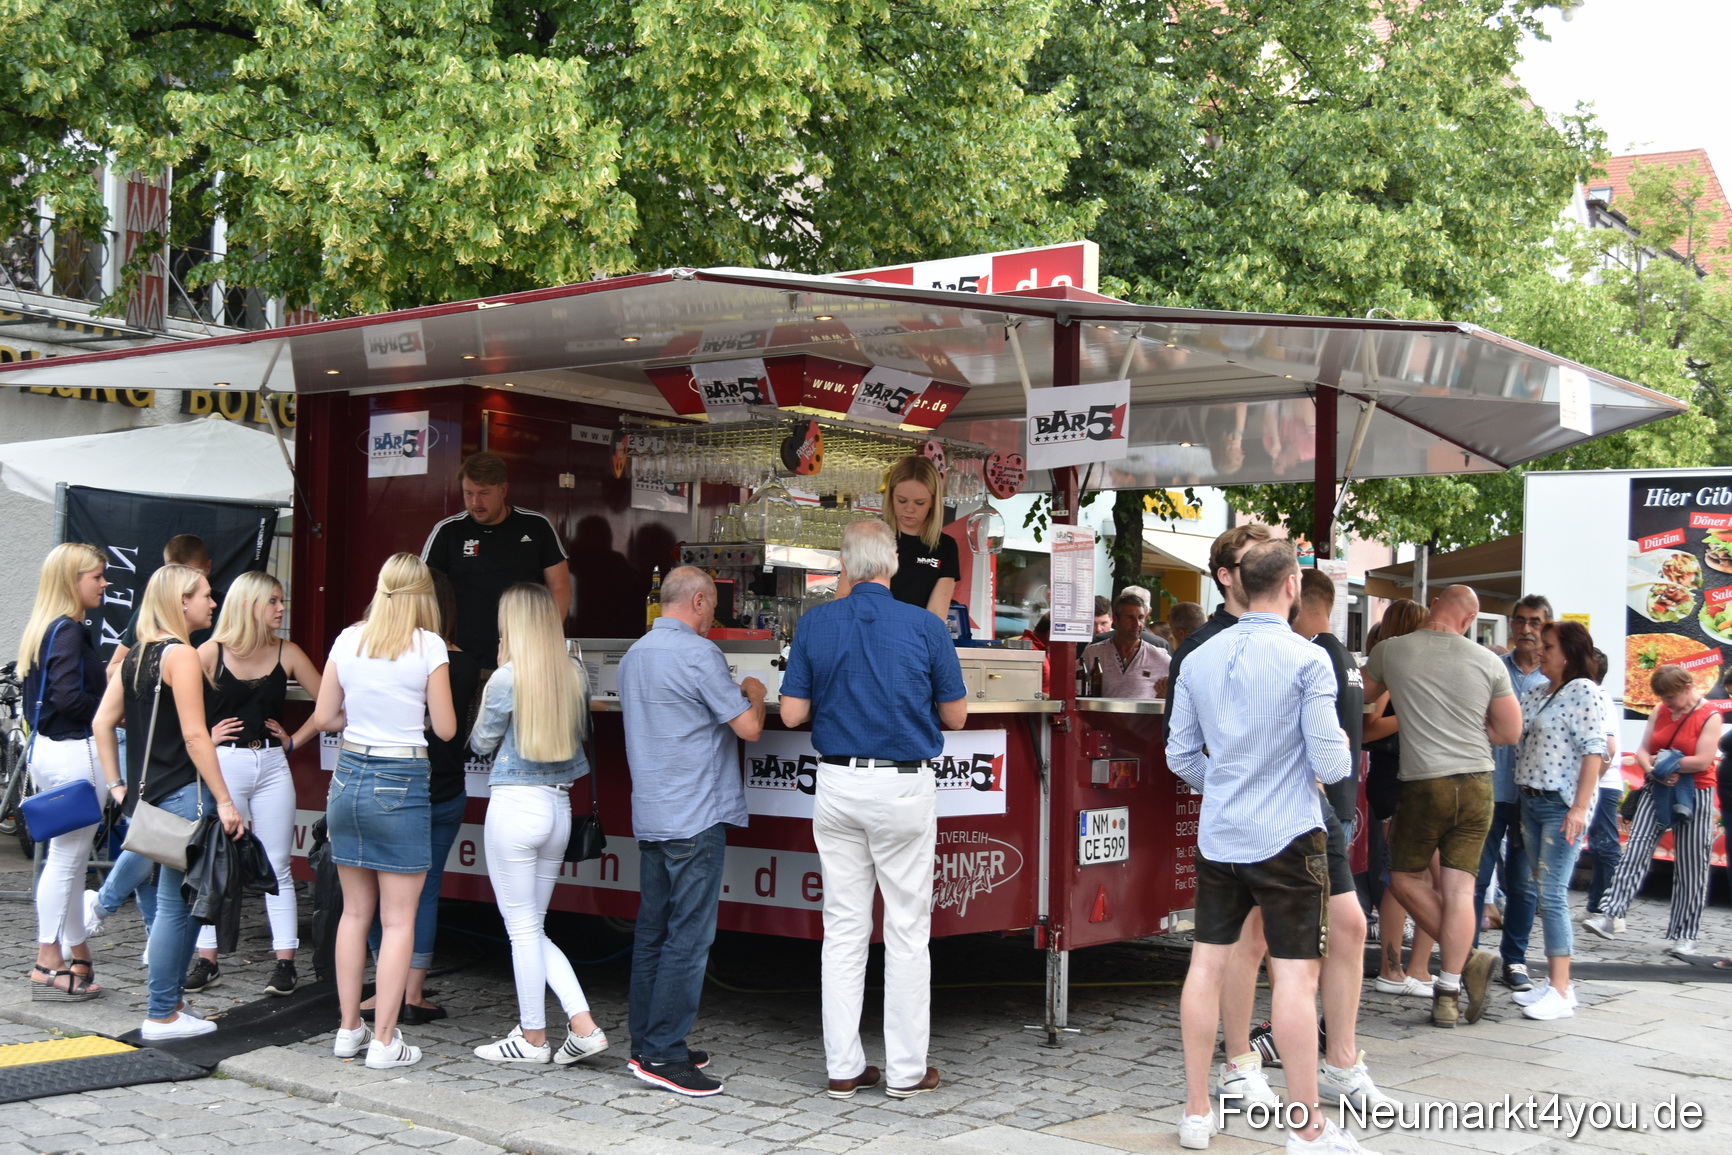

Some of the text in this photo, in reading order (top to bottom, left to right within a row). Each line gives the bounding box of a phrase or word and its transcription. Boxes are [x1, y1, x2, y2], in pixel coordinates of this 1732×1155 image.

[702, 380, 740, 398] BAR
[861, 382, 893, 402] BAR
[1035, 409, 1086, 435] BAR
[373, 432, 402, 451] BAR
[1643, 487, 1692, 507] Hier
[1692, 515, 1726, 527] Döner
[1644, 532, 1680, 550] Dürüm
[1677, 653, 1719, 669] hmacun
[750, 754, 797, 780] BAR
[1092, 813, 1109, 836] NM
[936, 830, 989, 846] TVERLEIH
[1085, 835, 1126, 861] CE 599
